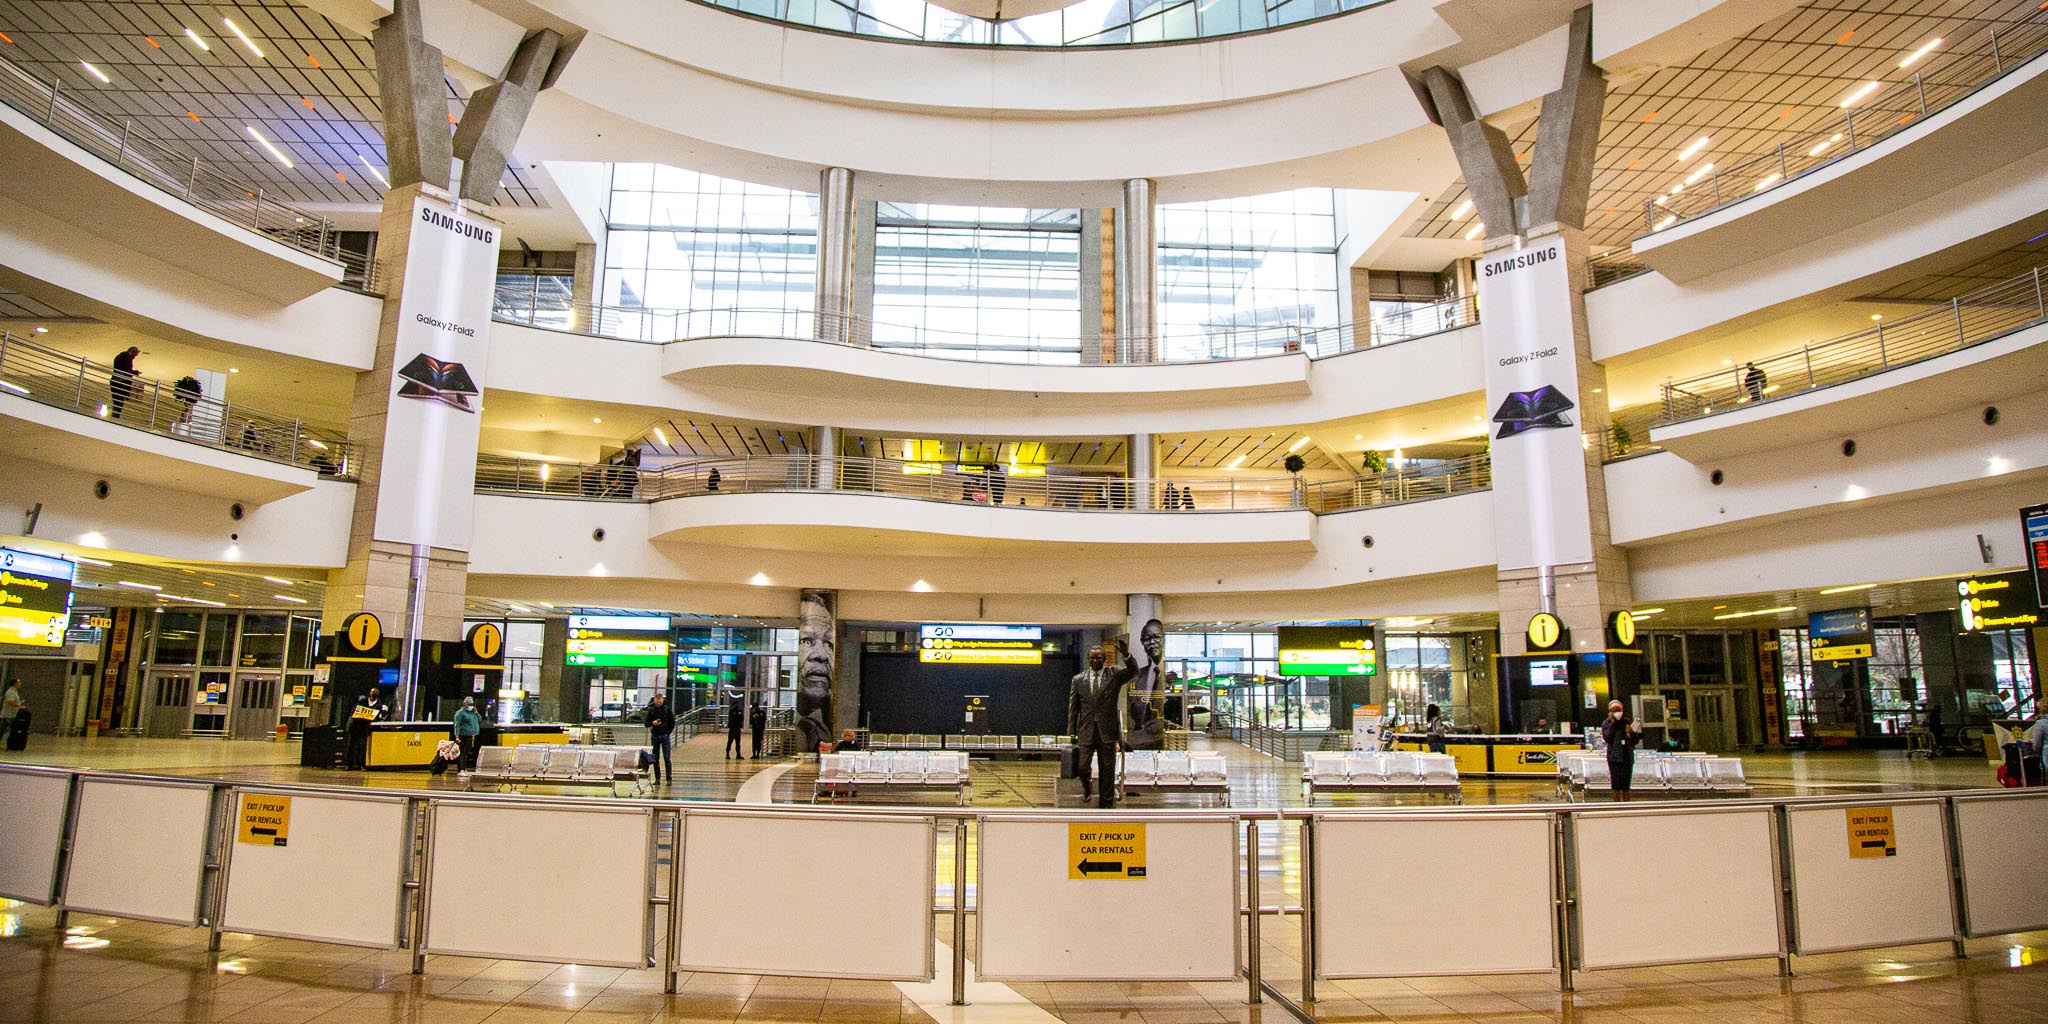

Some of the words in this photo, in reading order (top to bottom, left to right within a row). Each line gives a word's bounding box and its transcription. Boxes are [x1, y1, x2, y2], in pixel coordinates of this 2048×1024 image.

[422, 208, 493, 244] SAMSUNG
[1485, 247, 1557, 277] SAMSUNG
[416, 313, 447, 331] Galaxy
[447, 322, 453, 331] Z
[453, 324, 475, 338] Fold2
[1499, 355, 1529, 367] Galaxy
[1529, 352, 1535, 360] Z
[1535, 347, 1558, 359] Fold2
[246, 802, 258, 810] EXIT
[262, 803, 275, 812] PICK
[275, 805, 285, 813] UP
[246, 815, 257, 823] CAR
[257, 816, 282, 825] RENTALS
[1852, 817, 1865, 825] EXIT
[1868, 816, 1881, 824] PICK
[1881, 815, 1889, 823] UP
[1079, 833, 1097, 841] EXIT
[1097, 832, 1103, 842] /
[1104, 833, 1122, 841] PICK
[1123, 833, 1136, 841] UP
[1855, 829, 1867, 838] CAR
[1867, 828, 1889, 837] RENTALS
[1080, 846, 1097, 854] CAR
[1099, 846, 1134, 854] RENTALS
